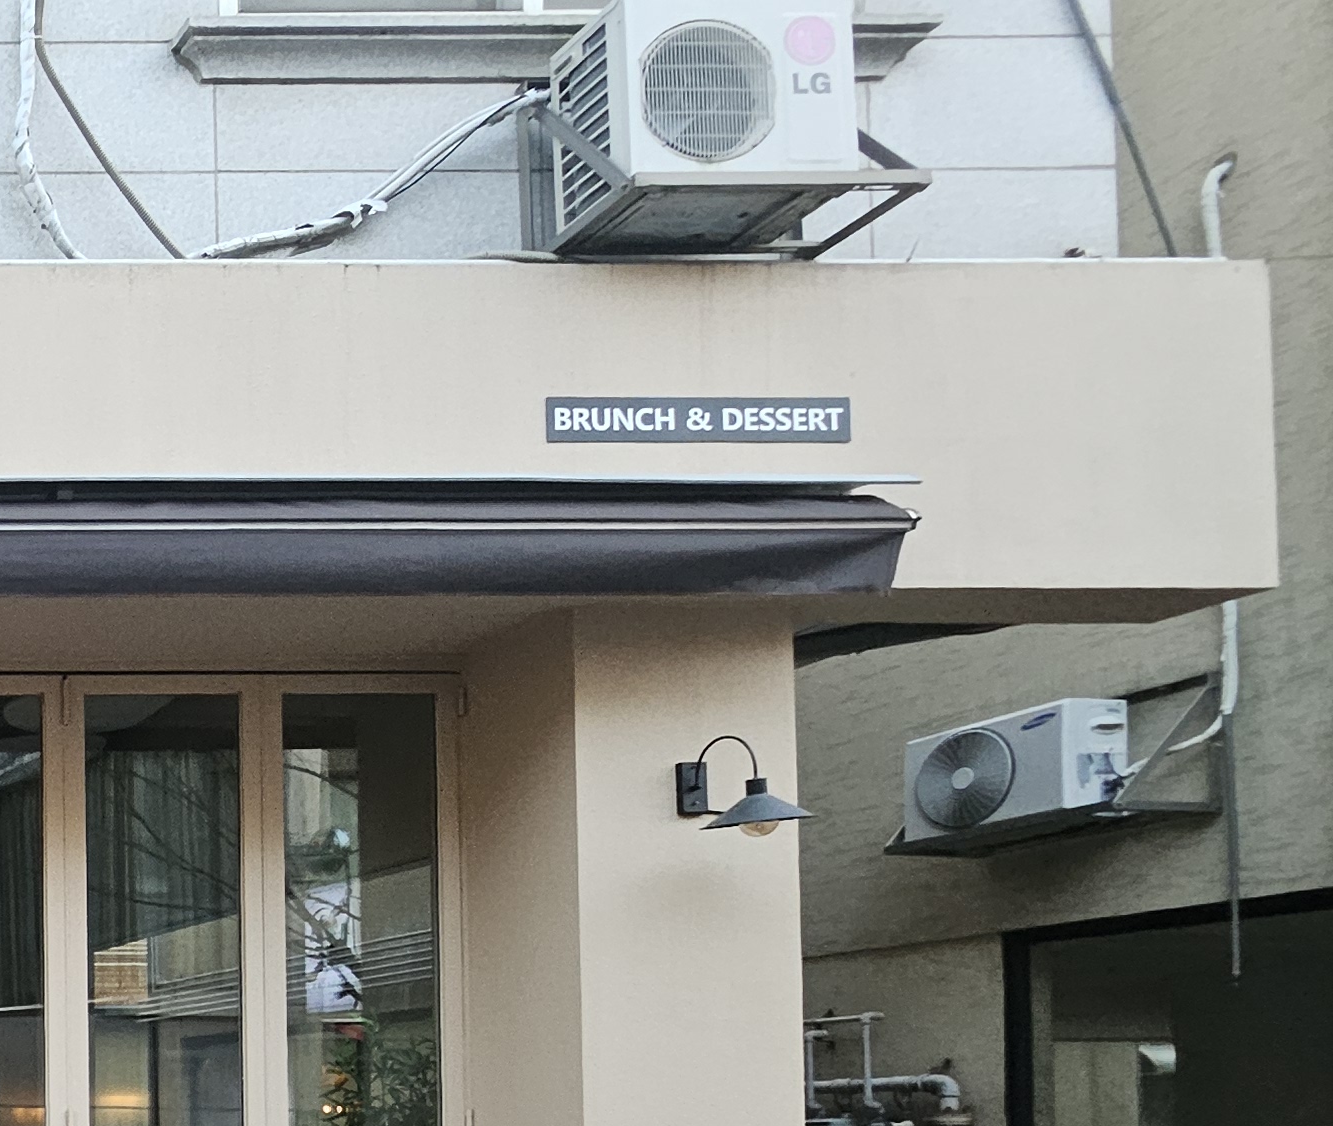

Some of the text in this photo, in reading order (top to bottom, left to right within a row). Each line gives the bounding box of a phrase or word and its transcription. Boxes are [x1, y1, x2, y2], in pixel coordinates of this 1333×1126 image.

[792, 72, 832, 95] LG
[554, 407, 845, 432] BRUNCH & DESSERT
